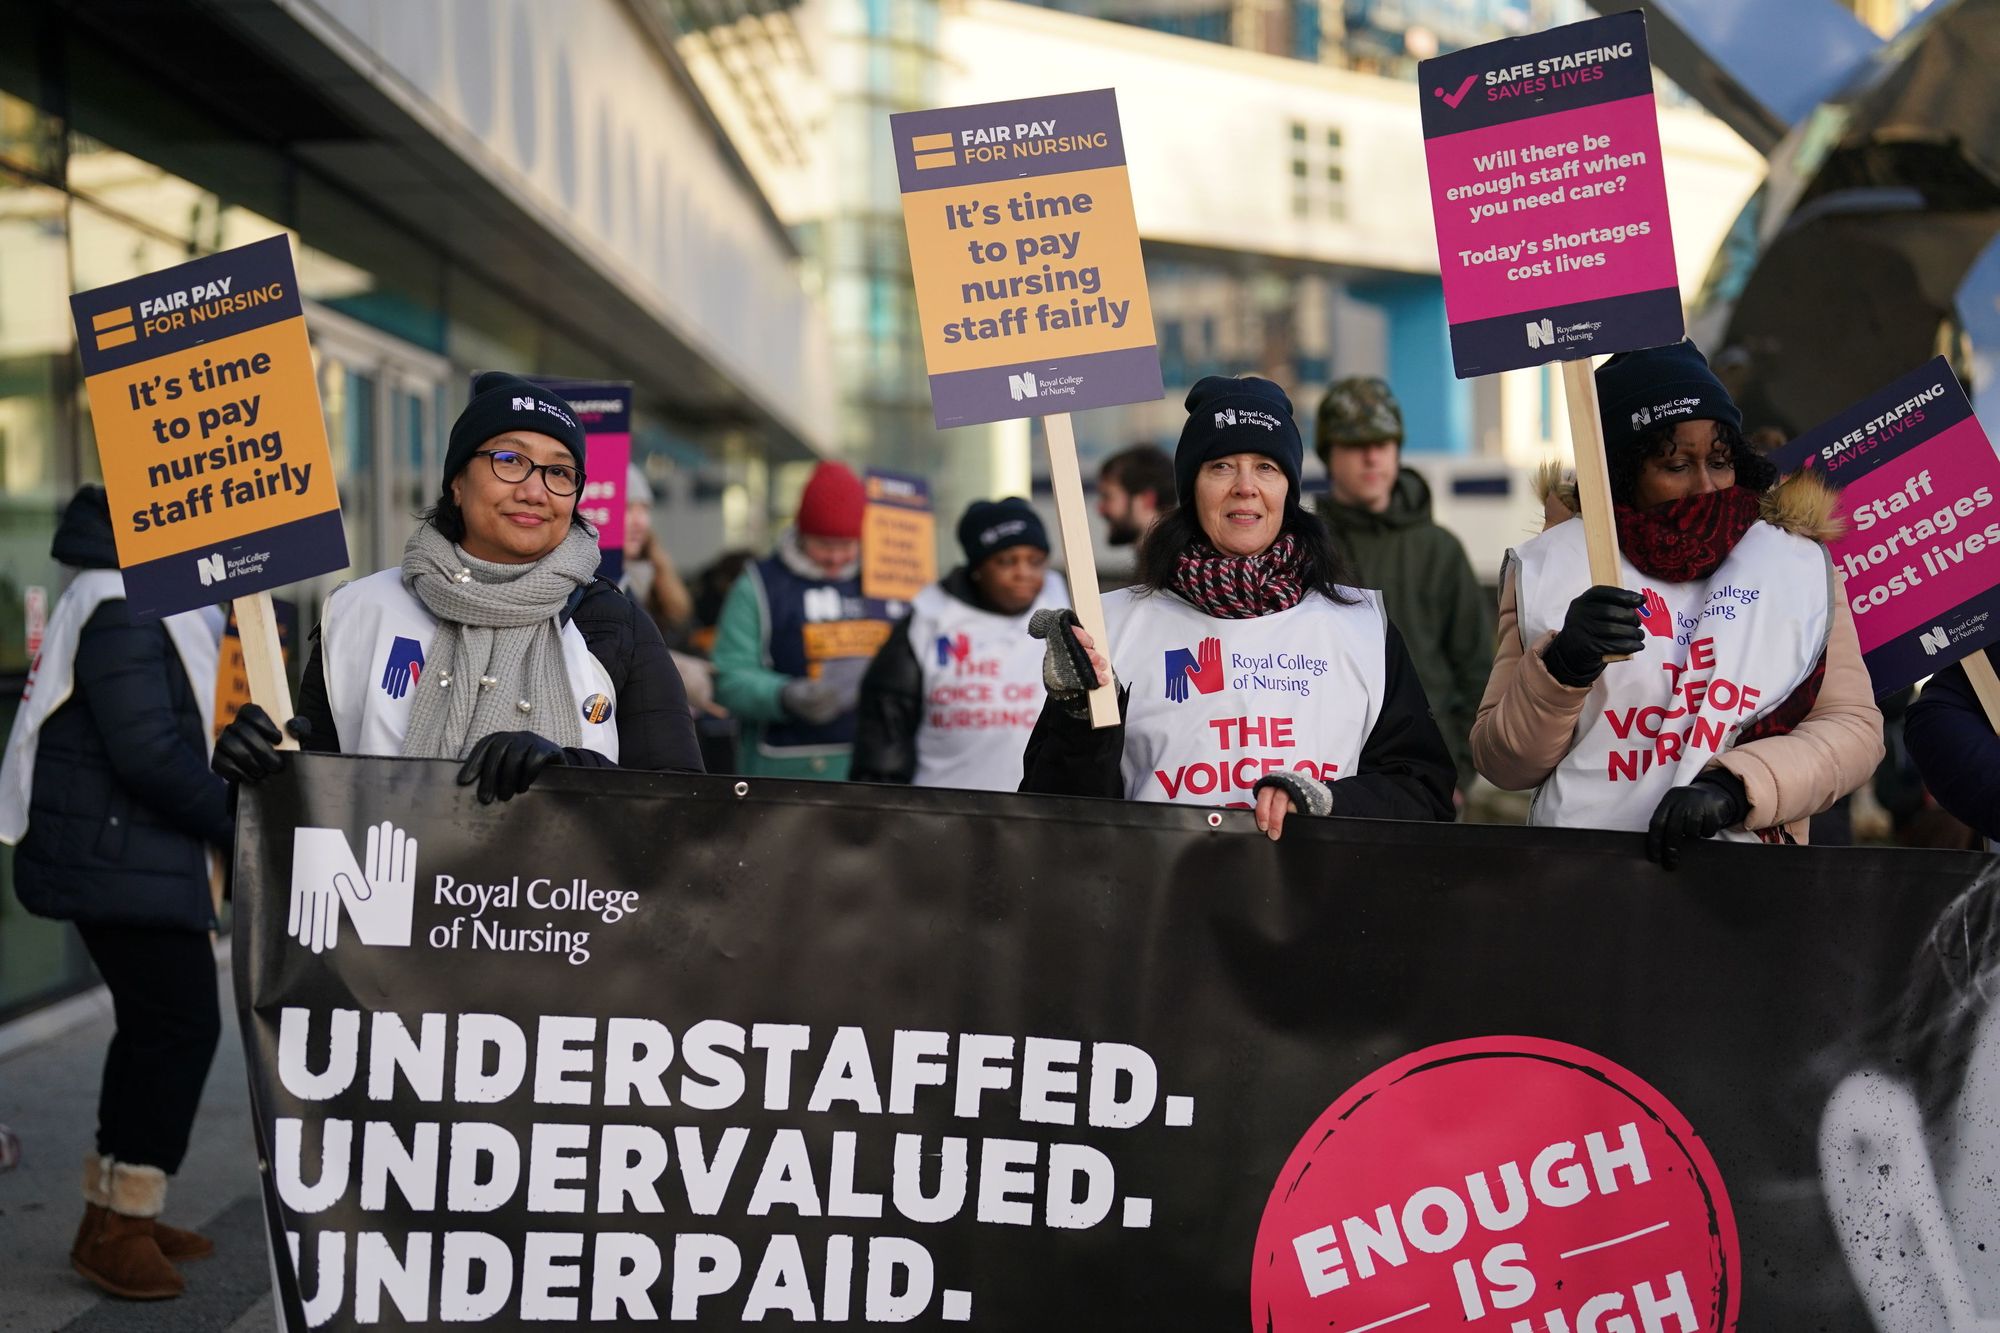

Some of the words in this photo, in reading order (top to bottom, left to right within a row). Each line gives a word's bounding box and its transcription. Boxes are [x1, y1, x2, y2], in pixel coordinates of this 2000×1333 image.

[1485, 63, 1535, 86] SAFE
[1538, 42, 1633, 74] STAFFING
[1487, 78, 1546, 102] SAVES
[1551, 66, 1604, 90] LIVES
[961, 126, 1011, 146] FAIR
[1015, 120, 1057, 139] PAY
[964, 147, 1007, 164] FOR
[1013, 133, 1108, 158] NURSING
[1473, 148, 1516, 173] Will
[1520, 139, 1578, 163] there
[1583, 134, 1611, 152] be
[1446, 172, 1526, 201] enough
[1529, 161, 1580, 185] staff
[1583, 151, 1646, 175] when
[1008, 191, 1093, 221] time
[1469, 198, 1509, 223] you
[1513, 185, 1565, 211] need
[1569, 175, 1627, 200] care?
[968, 239, 1008, 265] to
[1016, 231, 1081, 265] pay
[1541, 220, 1651, 252] shortages
[961, 264, 1101, 304] nursing
[1507, 258, 1552, 281] cost
[1556, 250, 1607, 274] lives
[139, 286, 189, 319] FAIR
[191, 276, 233, 308] PAY
[143, 310, 186, 338] FOR
[190, 282, 284, 326] NURSING
[943, 307, 1028, 344] staff
[1035, 297, 1131, 332] fairly
[1557, 335, 1565, 343] of
[1566, 332, 1594, 342] Nursing
[188, 351, 272, 393] time
[1039, 378, 1058, 388] Royal
[1059, 375, 1084, 385] College
[1041, 388, 1048, 396] of
[1049, 386, 1075, 395] Nursing
[152, 417, 190, 444] to
[198, 395, 261, 439] pay
[1248, 417, 1273, 431] Nursing
[1653, 401, 1672, 413] Royal
[1655, 412, 1663, 420] of
[1663, 406, 1693, 417] Nursing
[1821, 429, 1864, 460] SAFE
[1864, 383, 1945, 436] STAFFING
[147, 430, 284, 487] nursing
[1827, 437, 1879, 472] SAVES
[1880, 409, 1926, 444] LIVES
[132, 484, 215, 532] staff
[220, 462, 313, 508] fairly
[1853, 469, 1934, 531] Staff
[227, 556, 246, 569] Royal
[246, 551, 270, 564] College
[229, 568, 236, 578] of
[237, 563, 263, 576] Nursing
[1852, 565, 1922, 614] cost
[1921, 522, 2000, 577] lives
[1677, 632, 1692, 645] of
[1948, 622, 1966, 635] Royal
[1965, 611, 1989, 626] College
[1952, 635, 1960, 643] of
[1960, 624, 1985, 639] Nursing
[1232, 652, 1273, 675] Royal
[1277, 652, 1329, 677] College
[1662, 636, 1716, 696] TE
[1233, 674, 1250, 691] of
[1253, 675, 1310, 697] Nursing
[1708, 678, 1761, 716] OF
[1209, 716, 1296, 750] THE
[433, 873, 519, 918] Royal
[526, 878, 640, 924] College
[429, 916, 463, 949] of
[471, 919, 590, 965] Nursing
[277, 1007, 1195, 1130] UNDERSTAFFED.
[274, 1117, 1153, 1231] UNDERVALUED.
[1291, 1121, 1652, 1298] ENOUGH
[284, 1230, 973, 1329] UNDERPAID.
[1452, 1241, 1537, 1322] IS
